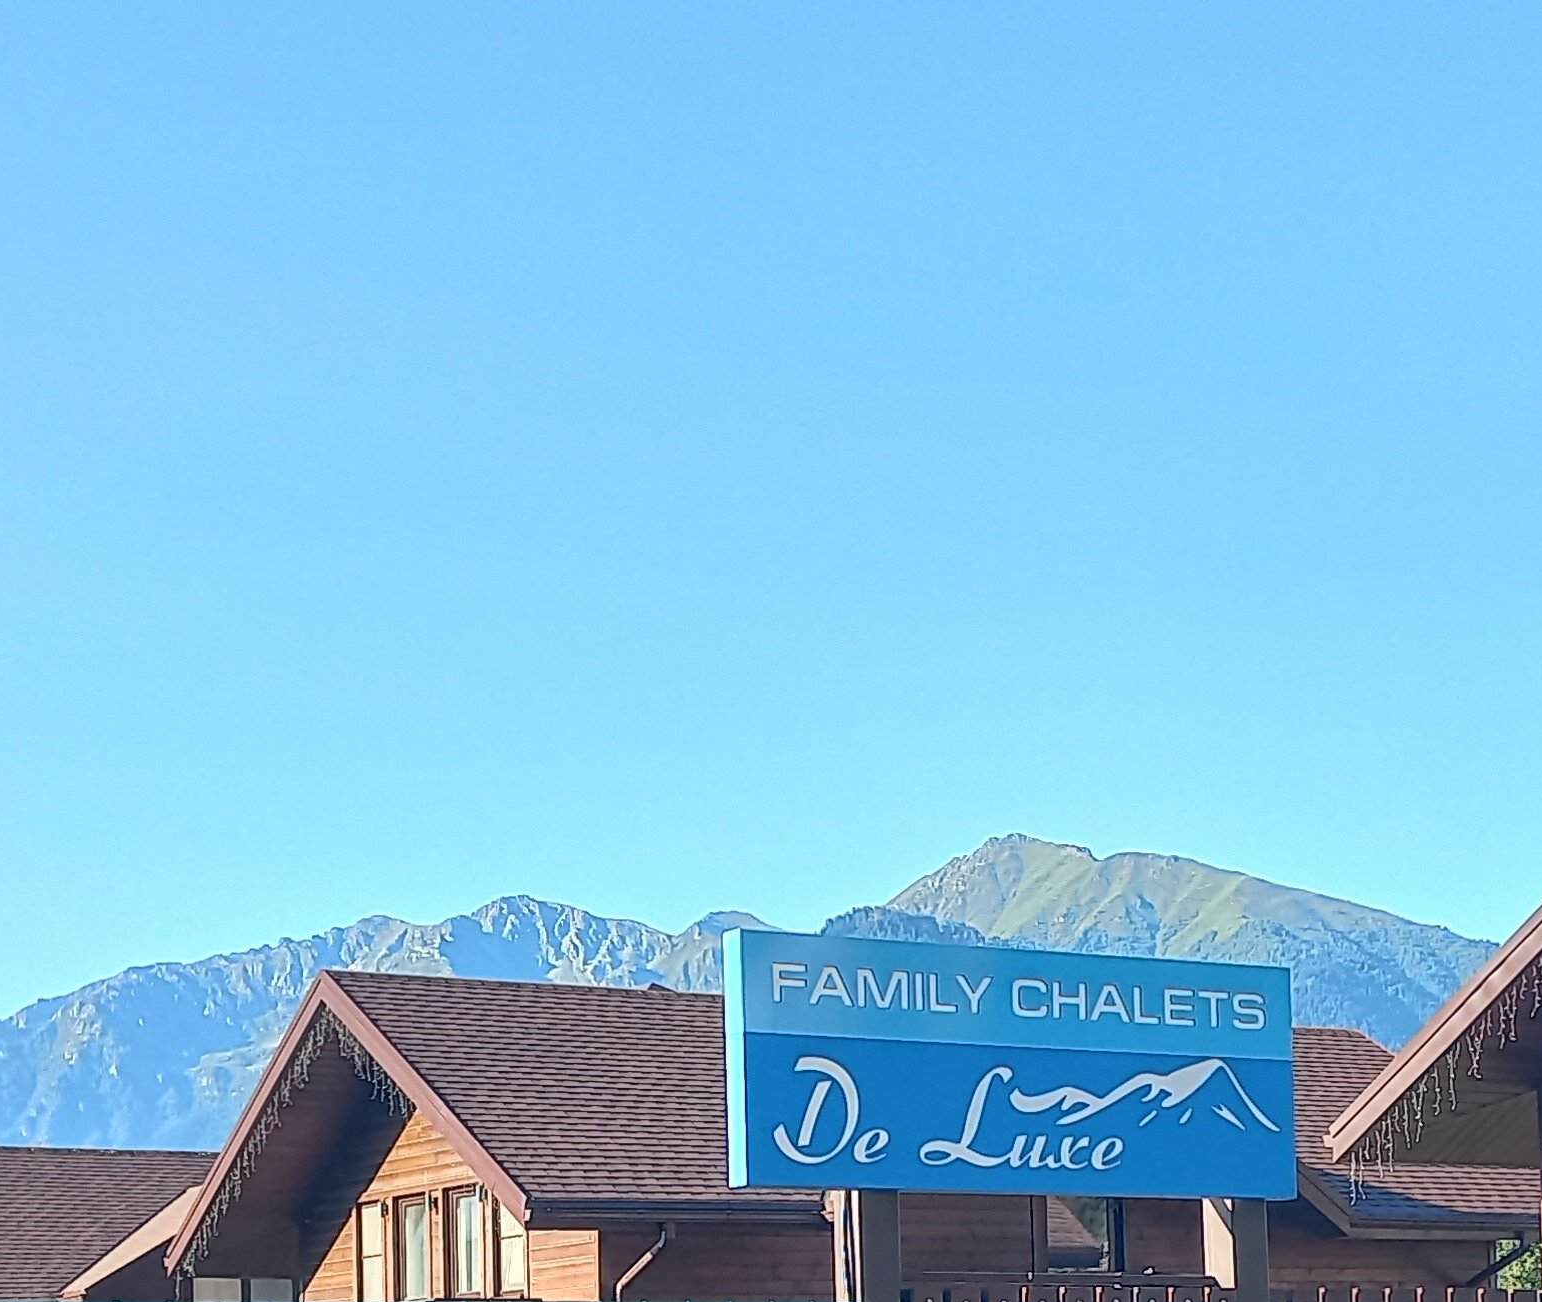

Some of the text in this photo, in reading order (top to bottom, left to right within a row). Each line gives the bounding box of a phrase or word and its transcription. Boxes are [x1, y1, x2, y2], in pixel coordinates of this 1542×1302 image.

[771, 961, 1267, 1031] FAMILY CHALETS
[772, 1055, 1125, 1171] De Luxe
